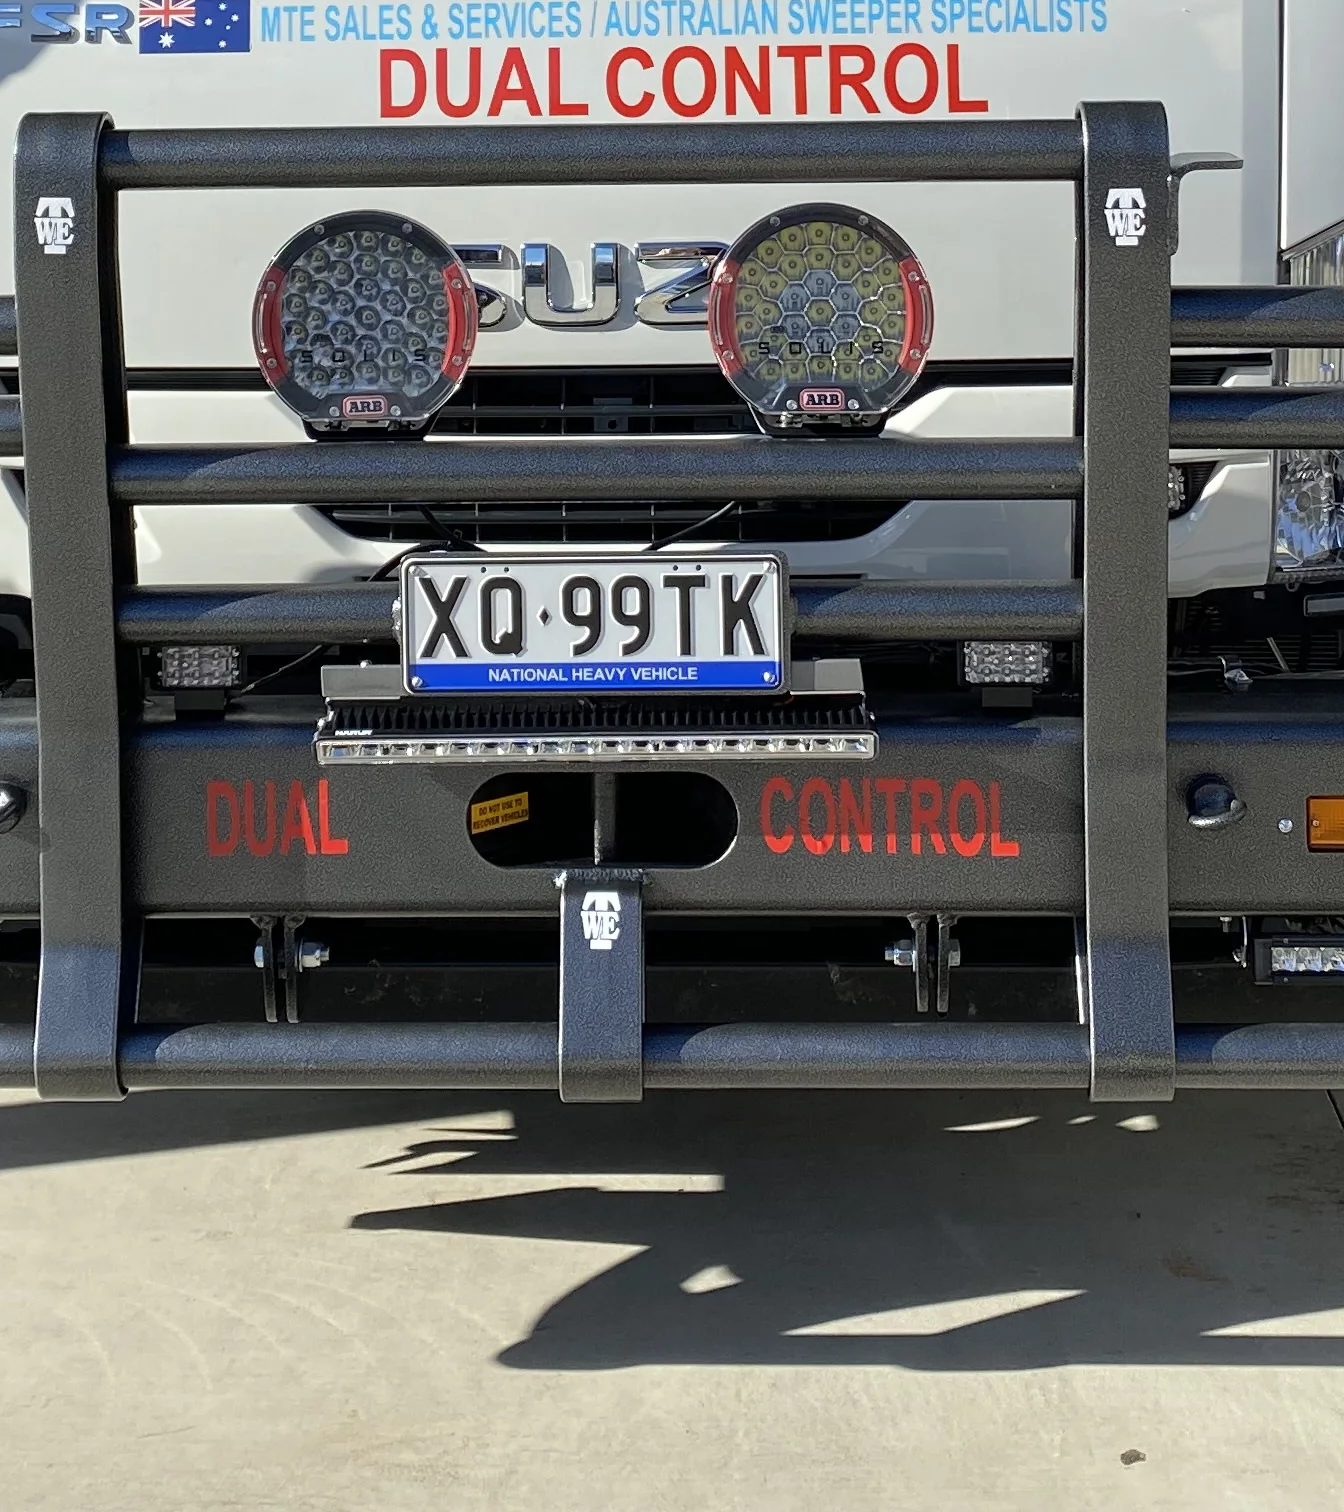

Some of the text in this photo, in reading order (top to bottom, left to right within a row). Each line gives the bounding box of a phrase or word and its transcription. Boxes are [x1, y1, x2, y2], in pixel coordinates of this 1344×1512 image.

[261, 5, 315, 42] MTE
[324, 3, 412, 41] SALES
[421, 3, 440, 40] &
[448, 1, 582, 40] SERVICES
[379, 42, 989, 118] DUAL CONTROL
[301, 348, 426, 364] SOLIS
[758, 341, 884, 355] SOLIS
[348, 400, 383, 413] ARB
[806, 393, 840, 406] ARB
[488, 666, 698, 683] NATIONAL HEAVY VEHICLE
[207, 778, 349, 857] DUAL
[473, 815, 500, 829] RECOVER
[760, 775, 1021, 857] CONTROL
